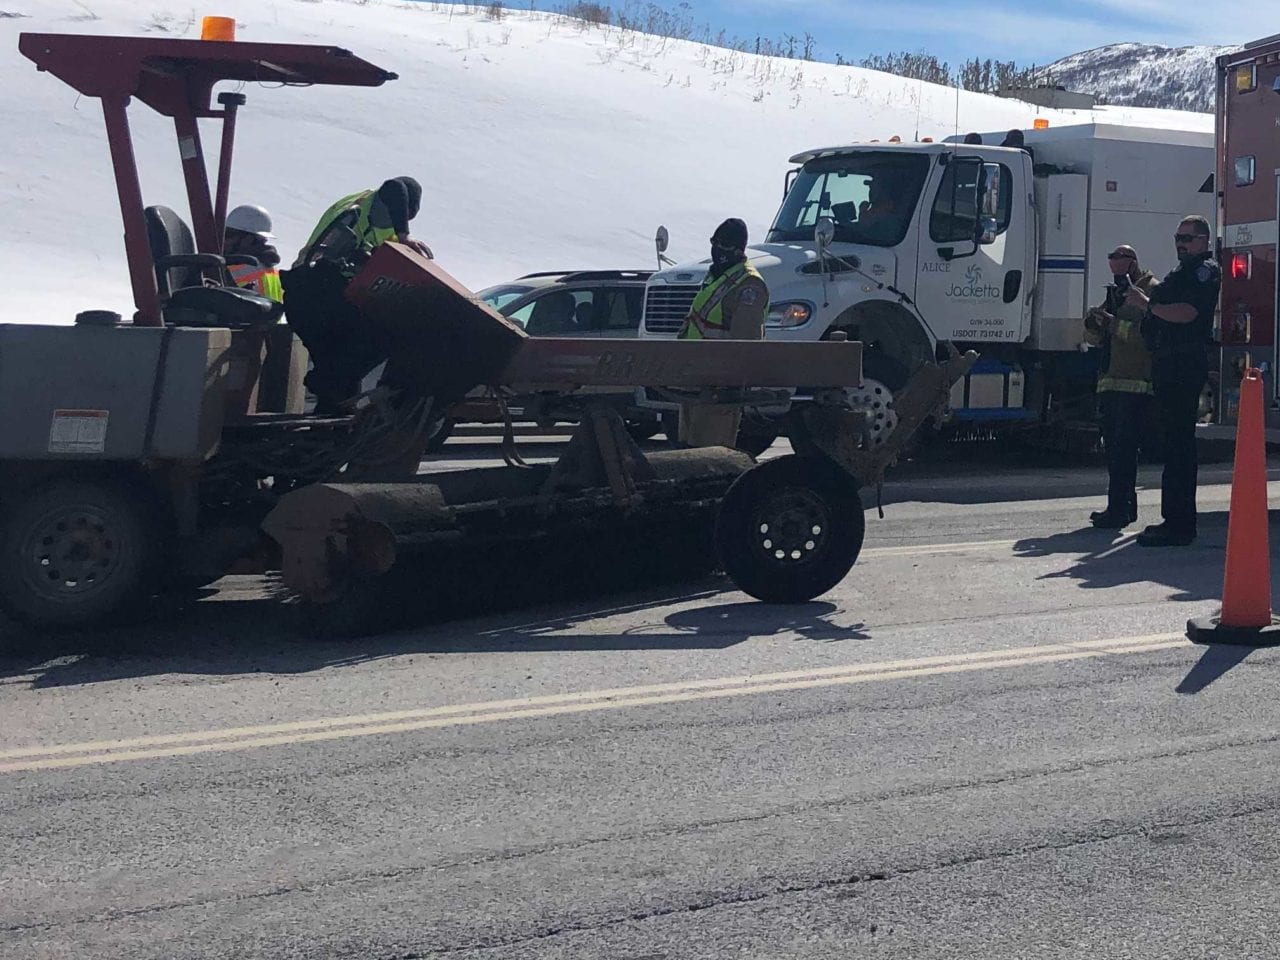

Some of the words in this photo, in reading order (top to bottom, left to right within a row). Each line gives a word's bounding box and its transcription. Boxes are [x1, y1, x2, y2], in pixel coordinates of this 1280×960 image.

[921, 262, 952, 272] ALICE
[945, 283, 1000, 298] Jacketta
[952, 329, 978, 338] USDOT
[980, 330, 1004, 339] 731742
[1005, 330, 1015, 339] UT
